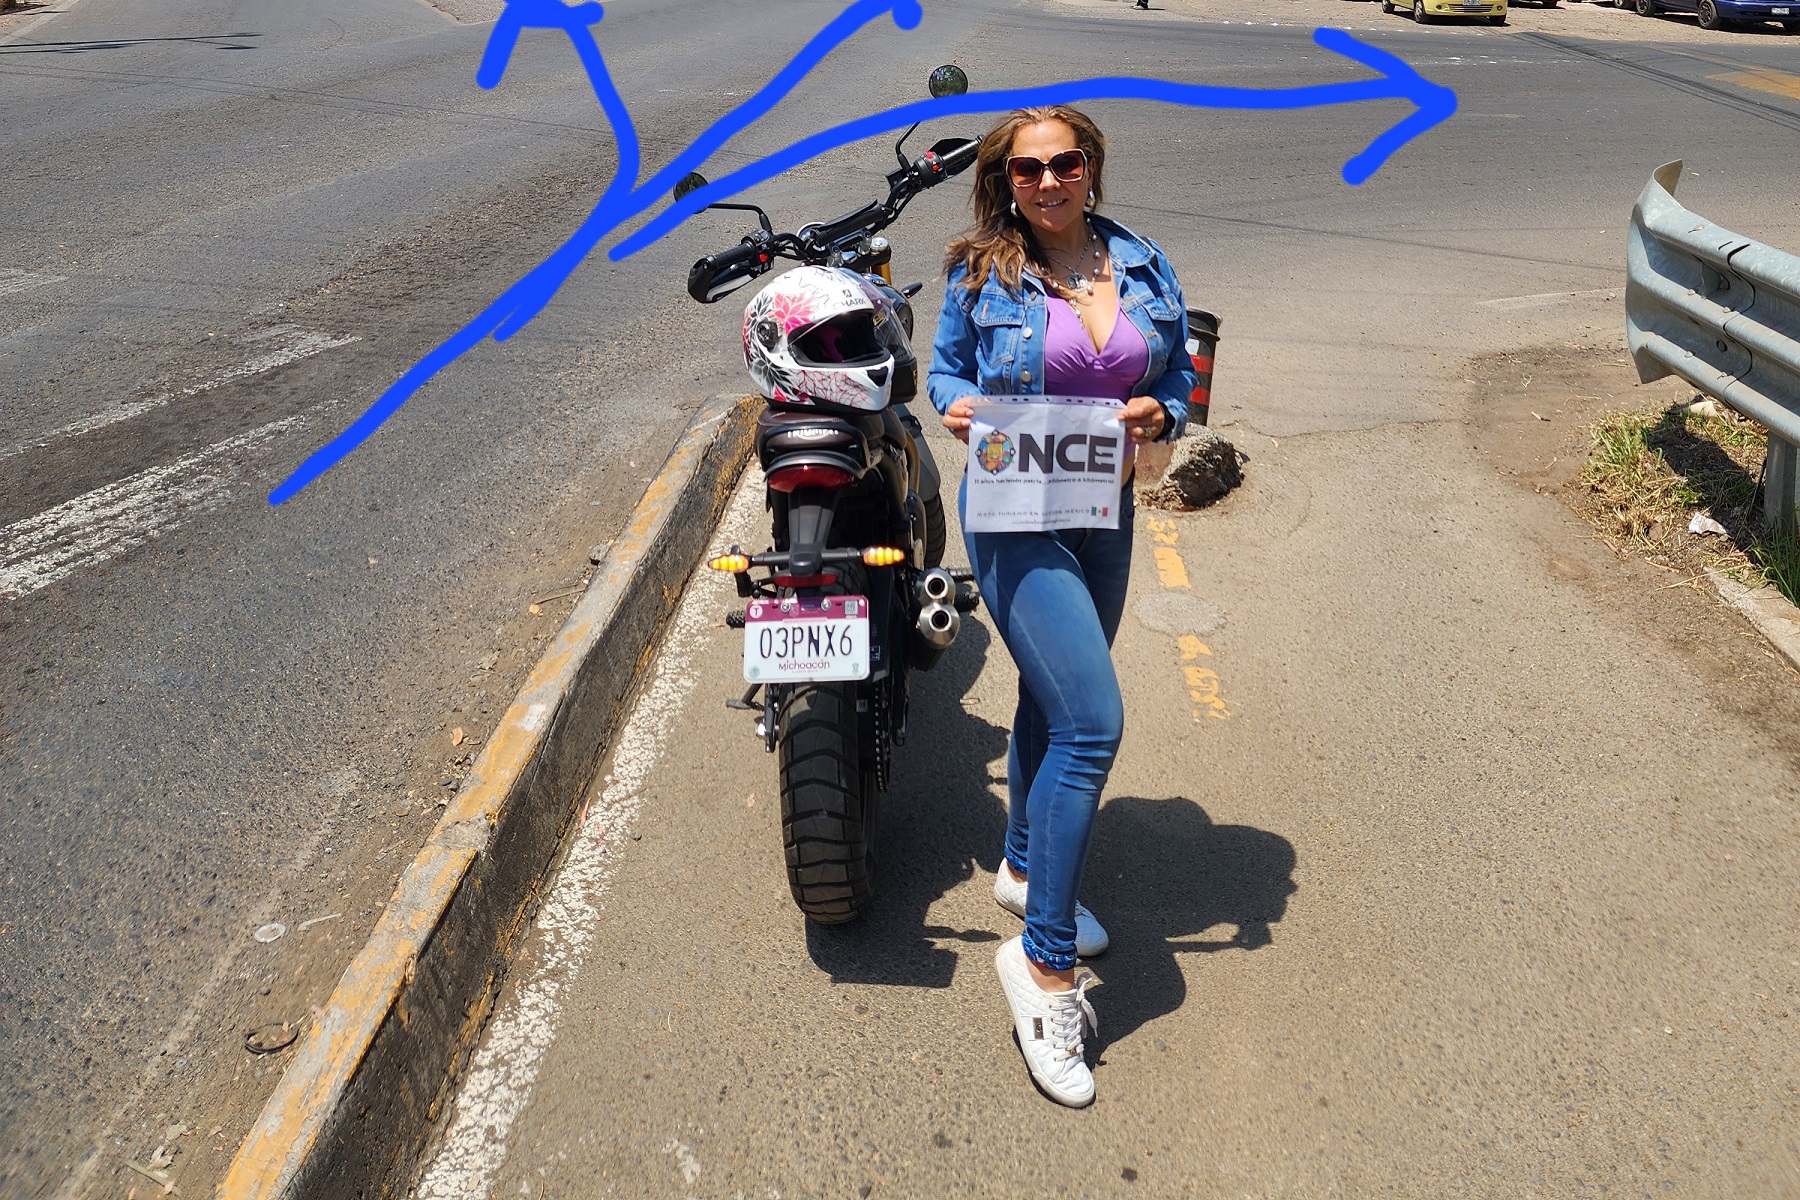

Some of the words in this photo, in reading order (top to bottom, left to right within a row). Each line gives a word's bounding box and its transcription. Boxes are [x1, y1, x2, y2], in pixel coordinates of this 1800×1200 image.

[753, 607, 760, 616] T
[759, 624, 853, 658] 03PNX6
[778, 659, 831, 671] Michoacán
